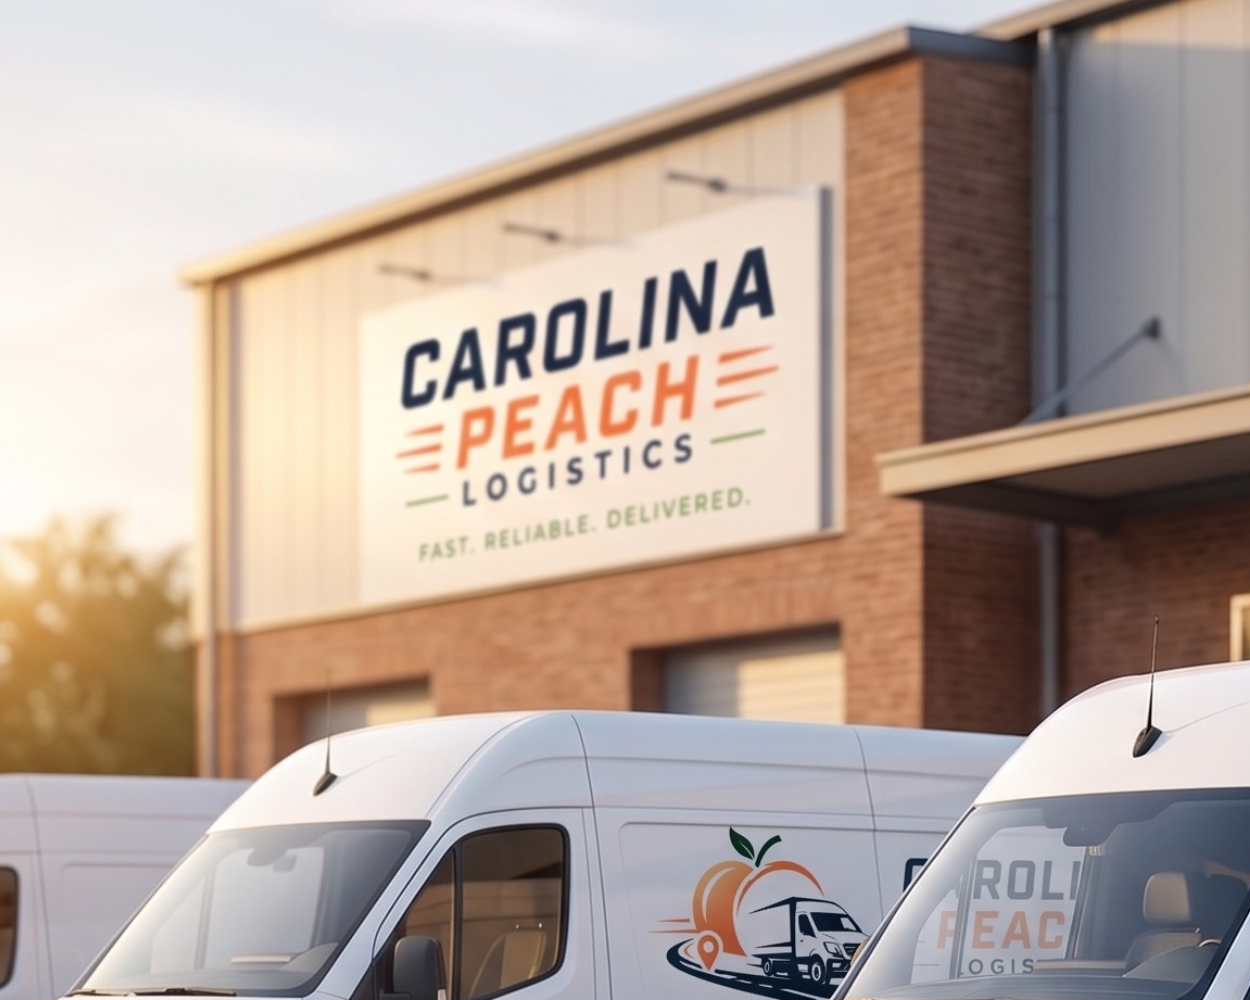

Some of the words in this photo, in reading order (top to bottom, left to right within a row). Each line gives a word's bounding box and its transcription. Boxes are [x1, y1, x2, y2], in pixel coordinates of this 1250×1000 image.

[401, 246, 775, 409] CAROLINA
[456, 354, 700, 471] PEACH
[462, 433, 693, 507] LOGISTICS
[418, 537, 474, 561] FAST.
[484, 513, 596, 550] RELIABLE.
[606, 486, 751, 530] DELIVERED.
